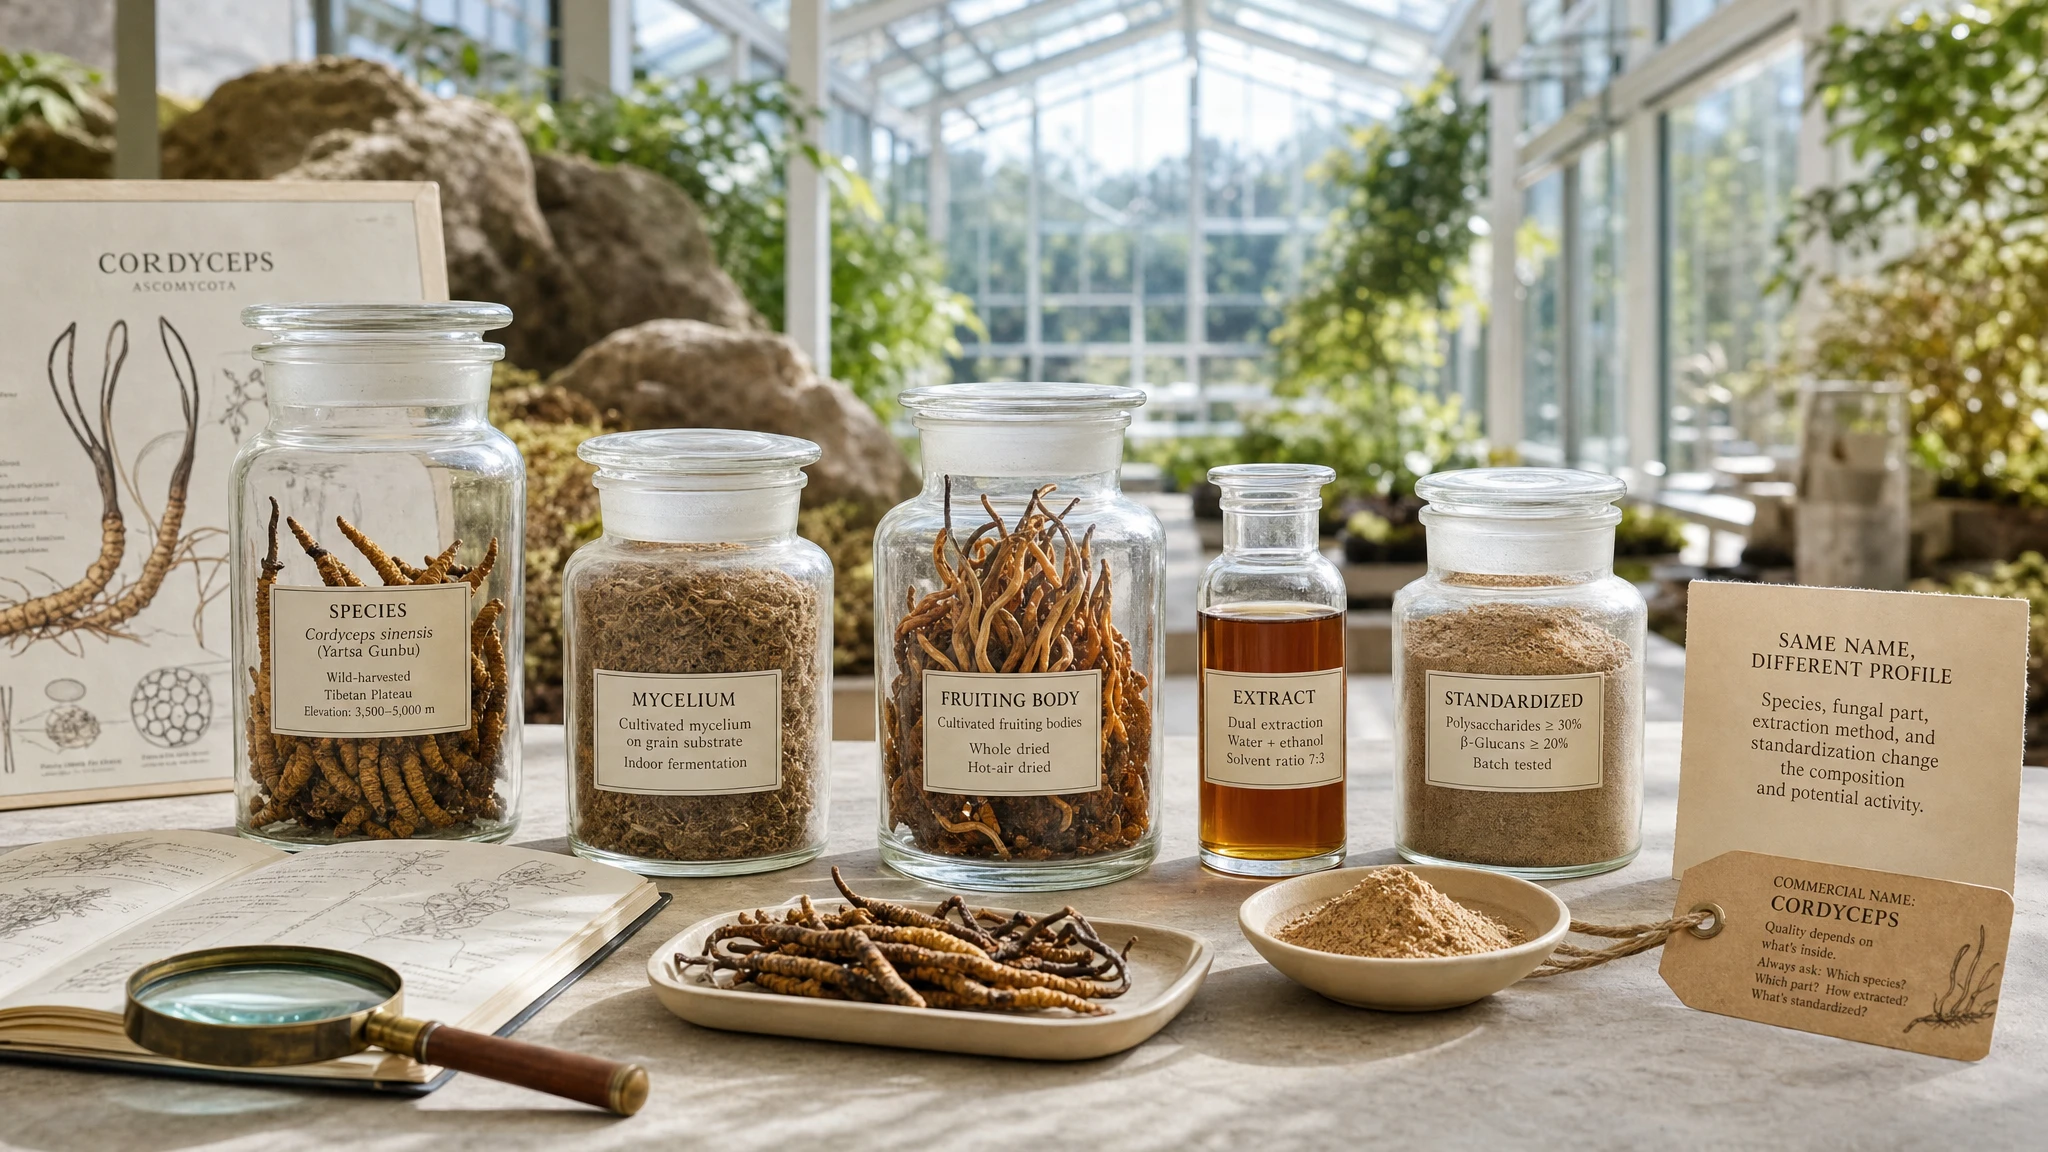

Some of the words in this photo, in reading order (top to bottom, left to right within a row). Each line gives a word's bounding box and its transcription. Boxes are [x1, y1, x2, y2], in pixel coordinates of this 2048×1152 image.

[98, 252, 274, 274] CORDYCEPS
[132, 280, 236, 292] ASCOMYCOTA
[329, 603, 407, 618] SPECIES
[305, 628, 375, 644] Cordyceps
[380, 626, 433, 640] sinensis
[317, 645, 363, 659] (Yartsa
[368, 644, 420, 658] Gunbu)
[1779, 632, 1836, 652] SAME
[1844, 637, 1916, 661] NAME,
[1751, 653, 1863, 677] DIFFERENT
[1869, 663, 1952, 684] PROFILE
[327, 671, 411, 683] Wild-harvested
[324, 690, 366, 700] Tibetan
[371, 689, 412, 700] Plateau
[632, 692, 736, 708] MYCELIUM
[941, 691, 1026, 708] FRUITING
[1032, 691, 1080, 707] BODY
[1233, 690, 1316, 705] EXTRACT
[1445, 691, 1583, 709] STANDARDIZED
[304, 706, 351, 717] Elevation:
[425, 706, 435, 714] m
[1762, 692, 1826, 714] Species,
[1833, 698, 1883, 720] fungal
[1889, 706, 1928, 724] part,
[619, 718, 684, 731] Cultivated
[689, 719, 751, 734] mycelium
[938, 716, 995, 730] Cultivated
[999, 718, 1042, 732] fruiting
[1047, 717, 1082, 729] bodies
[1228, 716, 1256, 729] Dual
[1261, 717, 1323, 730] extraction
[1446, 716, 1540, 732] Polysaccharides
[1558, 719, 1582, 730] 30%
[1752, 717, 1829, 735] extraction
[1835, 723, 1899, 744] method,
[1905, 730, 1935, 744] and
[627, 738, 641, 747] on
[646, 737, 678, 750] grain
[684, 737, 743, 748] substrate
[969, 742, 1011, 755] Whole
[1017, 743, 1050, 755] dried
[1228, 734, 1262, 747] Water
[1280, 734, 1323, 748] ethanol
[1460, 736, 1525, 750] β-Glucans
[1544, 738, 1568, 749] 20%
[1227, 752, 1270, 766] Solvent
[1276, 755, 1304, 766] ratio
[1309, 753, 1325, 764] 7:3
[1751, 738, 1876, 762] standardization
[1881, 750, 1939, 771] change
[624, 757, 663, 769] Indoor
[668, 757, 747, 770] fermentation
[968, 761, 1013, 773] Hot-air
[1018, 761, 1051, 773] dried
[1473, 757, 1509, 770] Batch
[1515, 758, 1552, 770] tested
[1780, 761, 1804, 776] the
[1809, 766, 1905, 788] composition
[1756, 783, 1786, 797] and
[1791, 786, 1858, 805] potential
[1864, 794, 1924, 815] activity.
[1773, 876, 1865, 900] COMMERCIAL
[1869, 890, 1915, 907] NAME:
[1771, 895, 1899, 928] CORDYCEPS
[1765, 921, 1806, 939] Quality
[1809, 928, 1855, 947] depends
[1859, 937, 1873, 947] on
[1762, 939, 1796, 954] what's
[1800, 943, 1836, 960] inside.
[1757, 957, 1796, 975] Always
[1799, 962, 1822, 977] ask:
[1826, 968, 1860, 983] Which
[1863, 975, 1907, 989] species?
[1755, 974, 1788, 988] Which
[1790, 980, 1820, 993] part?
[1825, 985, 1851, 998] How
[1853, 988, 1909, 1006] extracted?
[1752, 989, 1787, 1005] What's
[1790, 996, 1868, 1017] standardized?
